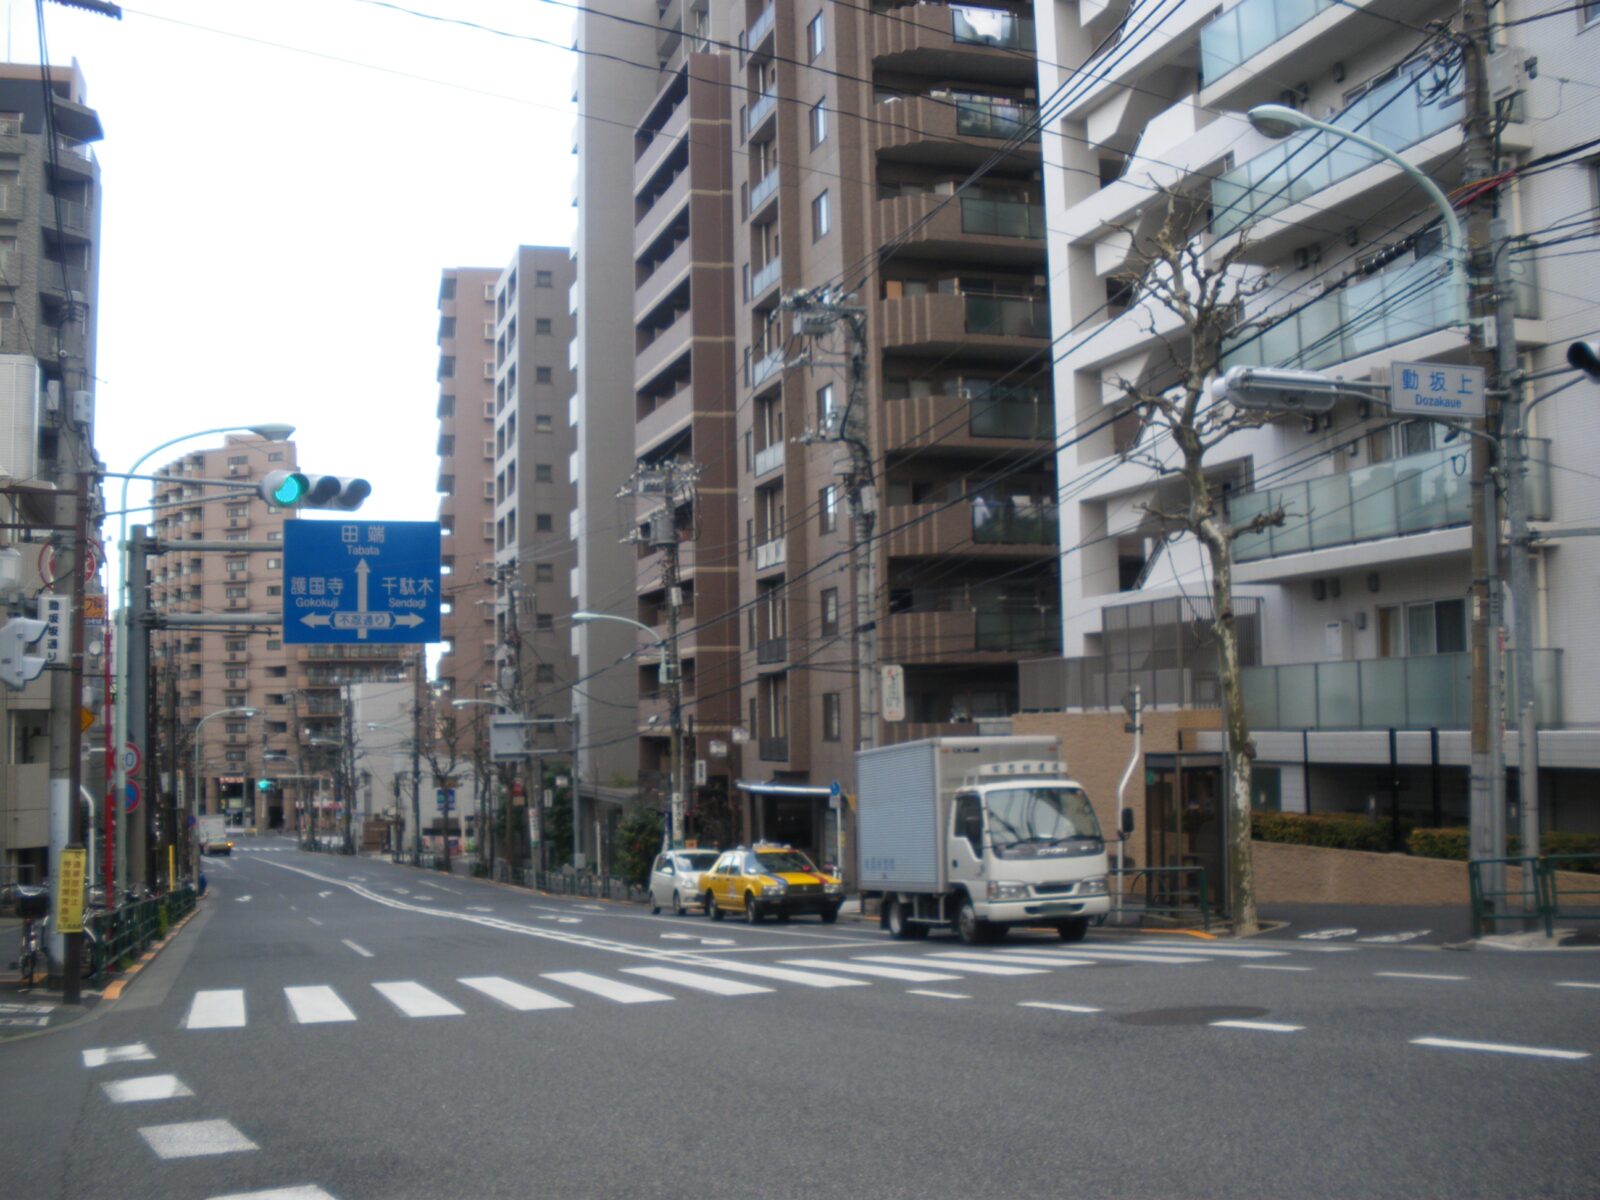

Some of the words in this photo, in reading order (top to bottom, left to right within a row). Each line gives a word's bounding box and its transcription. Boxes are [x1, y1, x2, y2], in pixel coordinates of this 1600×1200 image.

[1402, 368, 1474, 395] 動坂上
[1415, 394, 1462, 408] Dozakaue
[341, 525, 385, 543] 田端
[346, 545, 380, 556] Tabata
[290, 577, 344, 596] 護国寺
[381, 577, 434, 596] 千駄木
[296, 597, 339, 608] Gokokuji
[389, 597, 427, 608] Sendagi
[338, 614, 386, 626] 不忍通り
